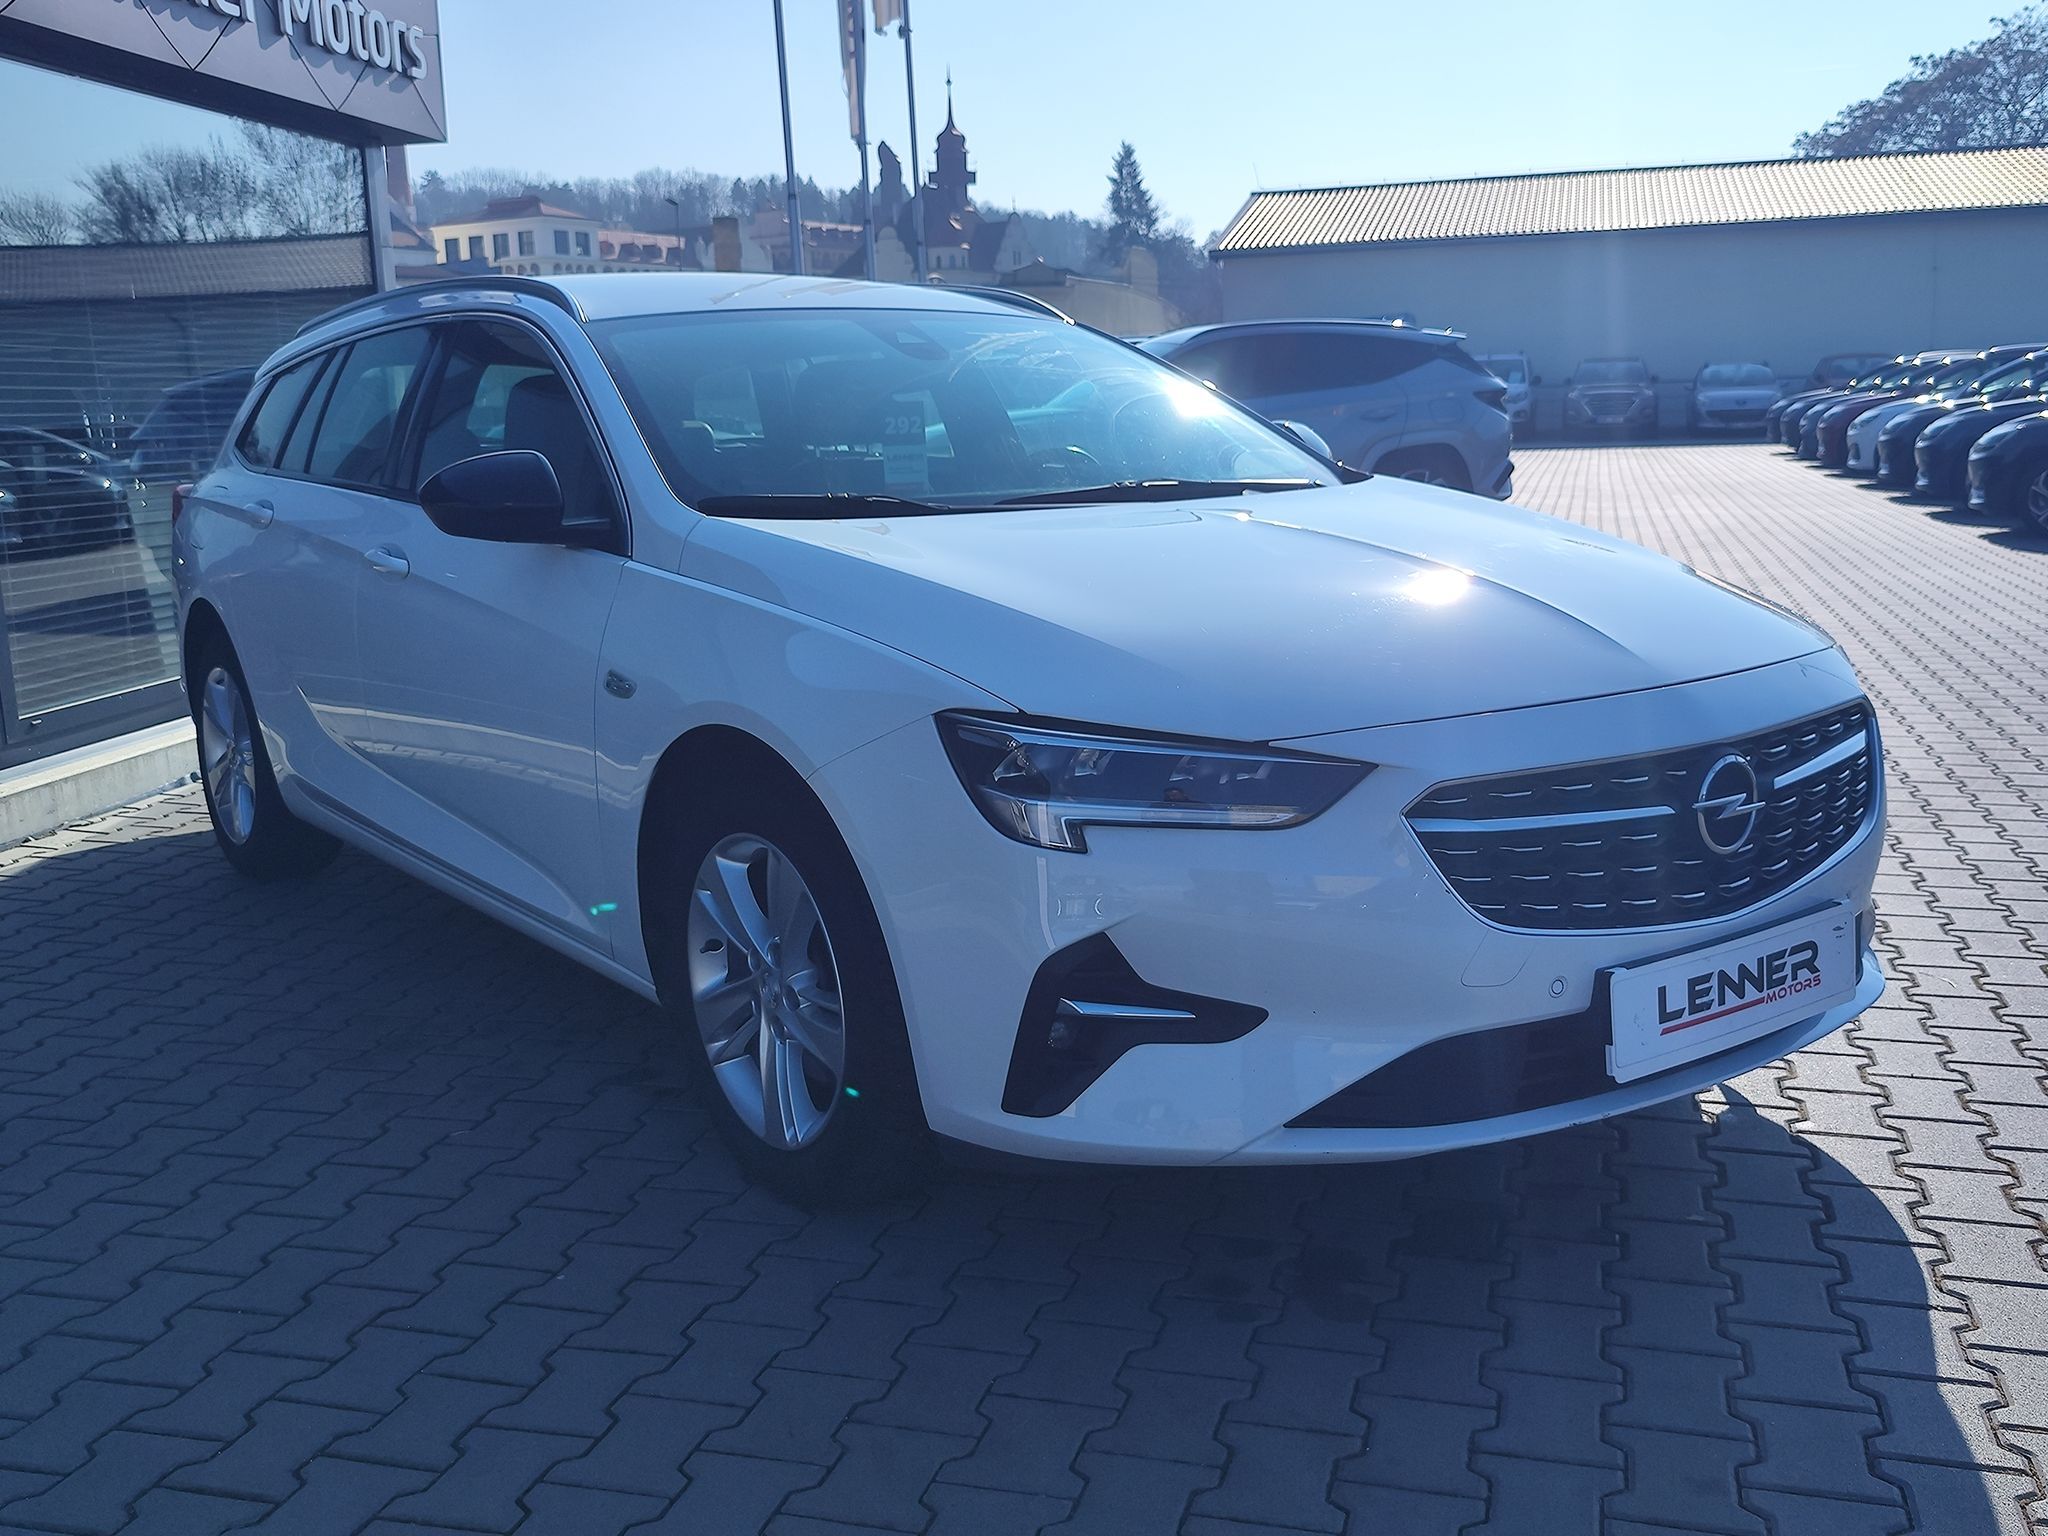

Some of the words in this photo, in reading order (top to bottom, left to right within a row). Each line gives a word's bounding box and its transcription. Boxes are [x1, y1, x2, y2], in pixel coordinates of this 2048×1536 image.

[884, 416, 922, 435] 292
[1657, 940, 1821, 1025] LENNER
[1765, 974, 1822, 1005] MOTORS
